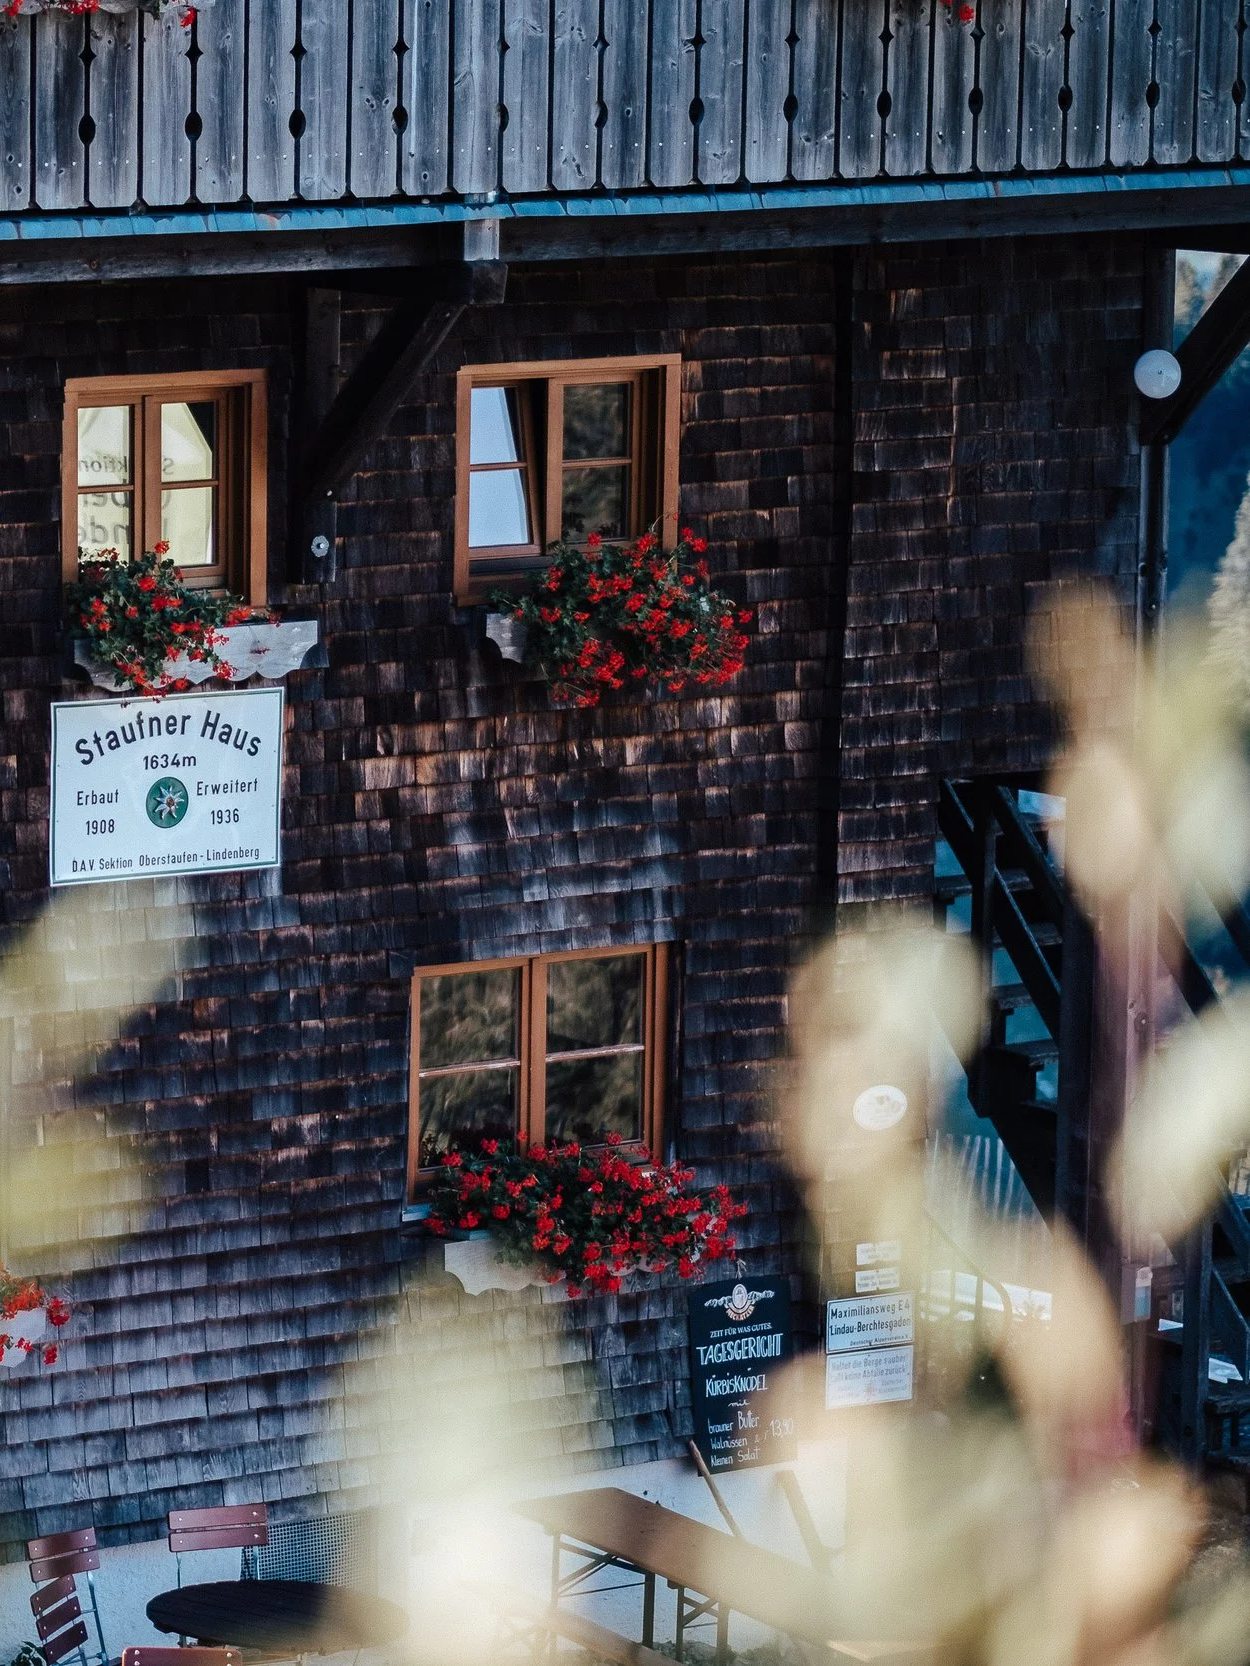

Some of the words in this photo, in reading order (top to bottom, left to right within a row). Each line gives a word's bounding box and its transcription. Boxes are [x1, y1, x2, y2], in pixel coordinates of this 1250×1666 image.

[75, 711, 191, 765] Staufner
[200, 710, 261, 756] Haus
[143, 753, 196, 770] 1634m
[196, 778, 258, 796] Erweitert
[77, 789, 119, 806] Erbaut
[210, 809, 240, 825] 1936
[85, 819, 115, 835] 1908
[99, 857, 133, 870] Sektion
[830, 1303, 896, 1320] Maximiliansweg
[898, 1300, 904, 1311] E
[710, 1329, 724, 1338] ZEIT
[724, 1326, 737, 1336] FÜR
[737, 1325, 751, 1334] WAS
[695, 1333, 783, 1366] TAGESGERICHT
